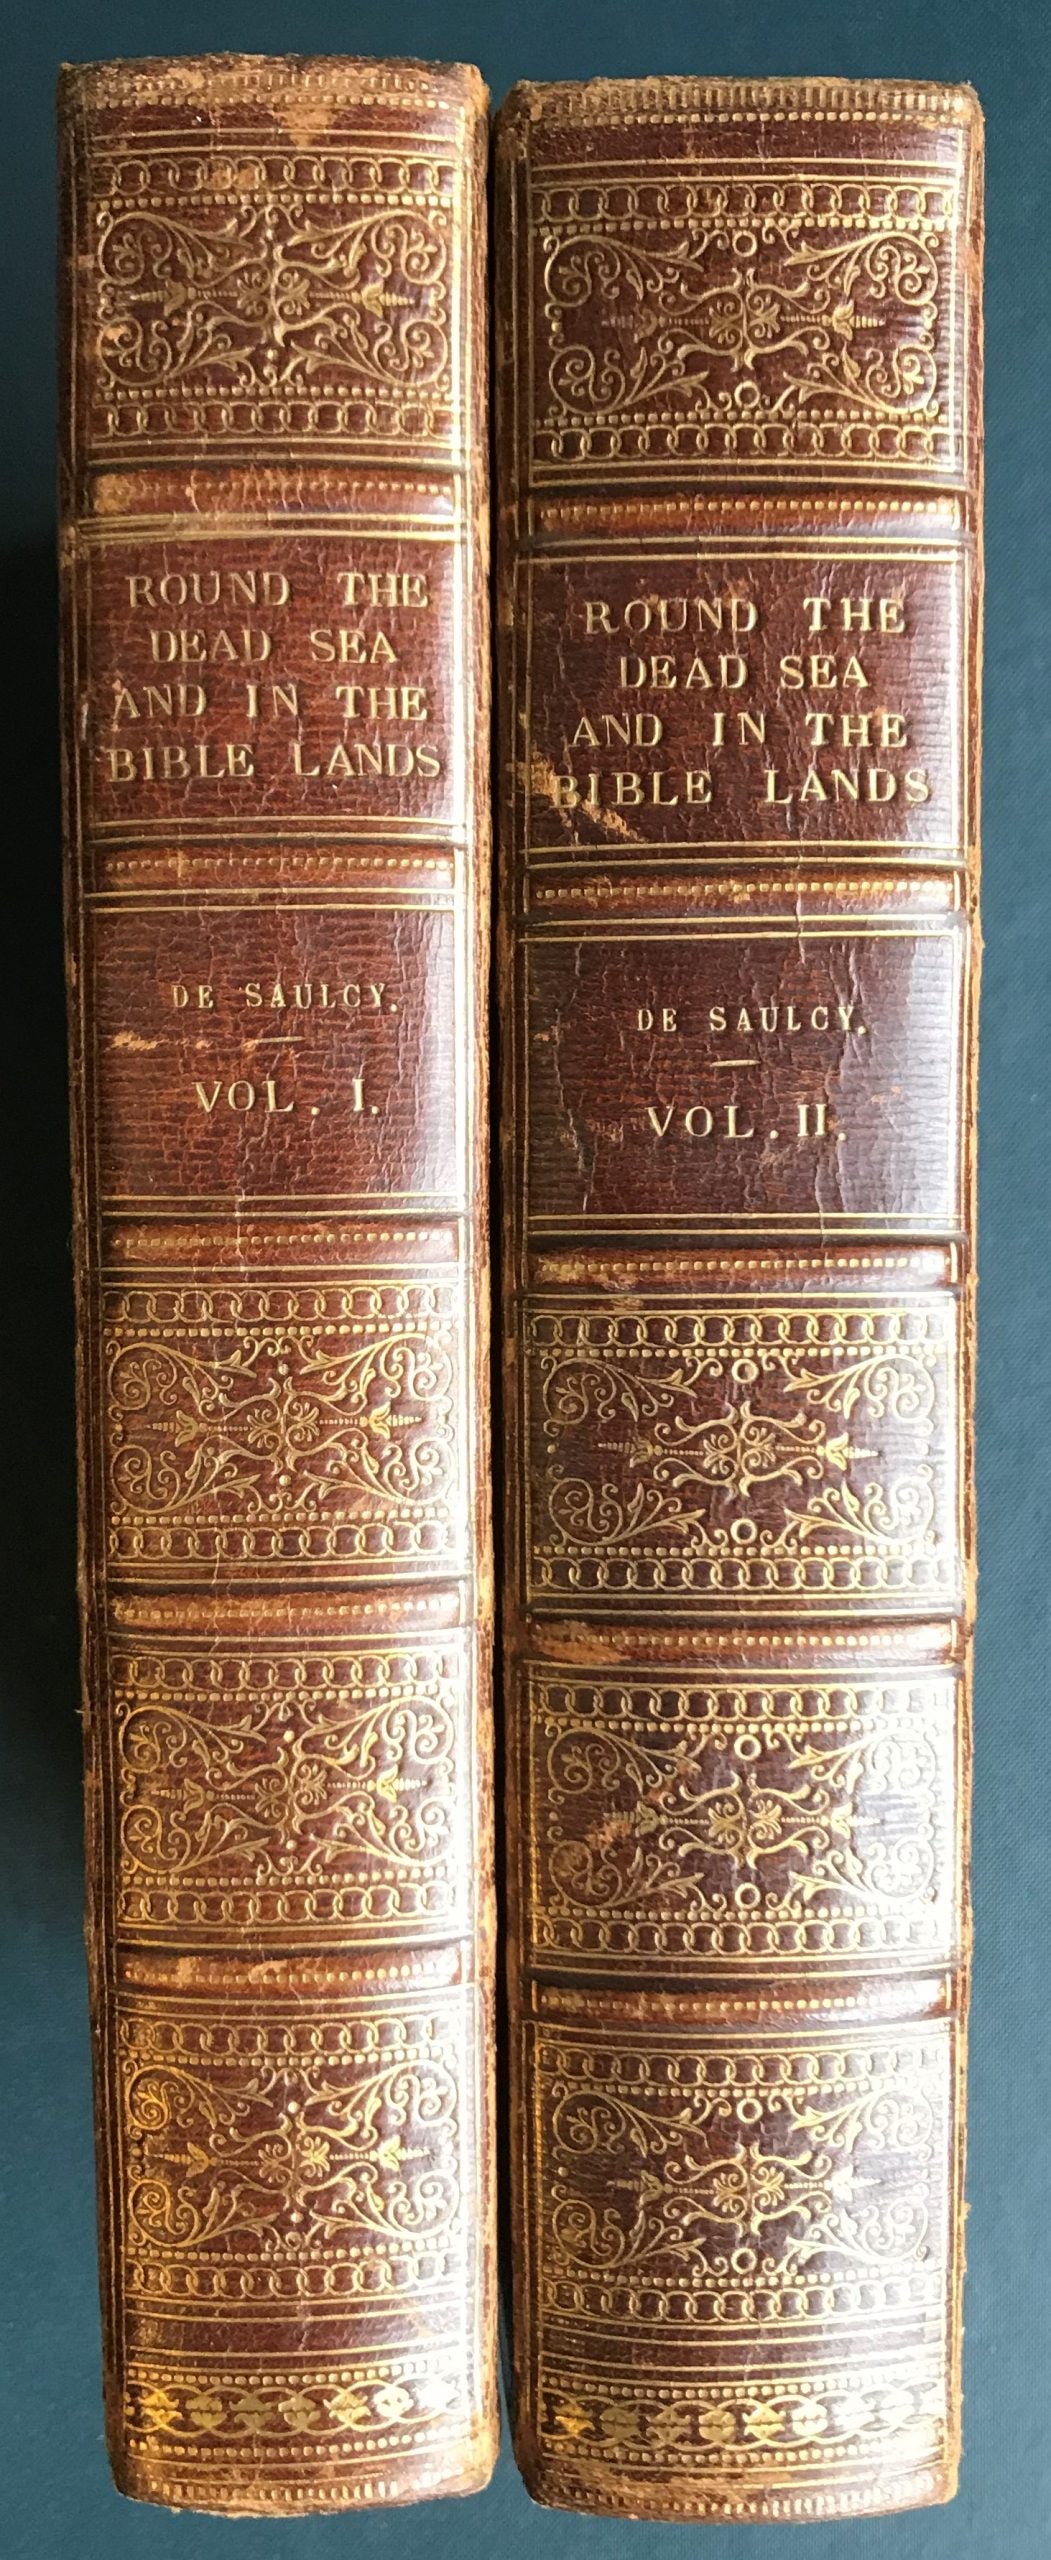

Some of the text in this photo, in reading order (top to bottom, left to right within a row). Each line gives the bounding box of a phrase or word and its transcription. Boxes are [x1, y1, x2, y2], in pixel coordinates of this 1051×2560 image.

[125, 571, 429, 607] ROUND THE
[584, 597, 906, 635] ROUND THE
[150, 629, 398, 664] DEAD SEA
[620, 654, 869, 689] DEAD SEA
[113, 684, 428, 721] AND IN THE
[572, 712, 908, 748] AND IN THE
[109, 743, 441, 783] BIBLE LANDS
[554, 768, 930, 809] BIBLE LANDS
[172, 984, 213, 1009] DE
[638, 1008, 676, 1032] DE
